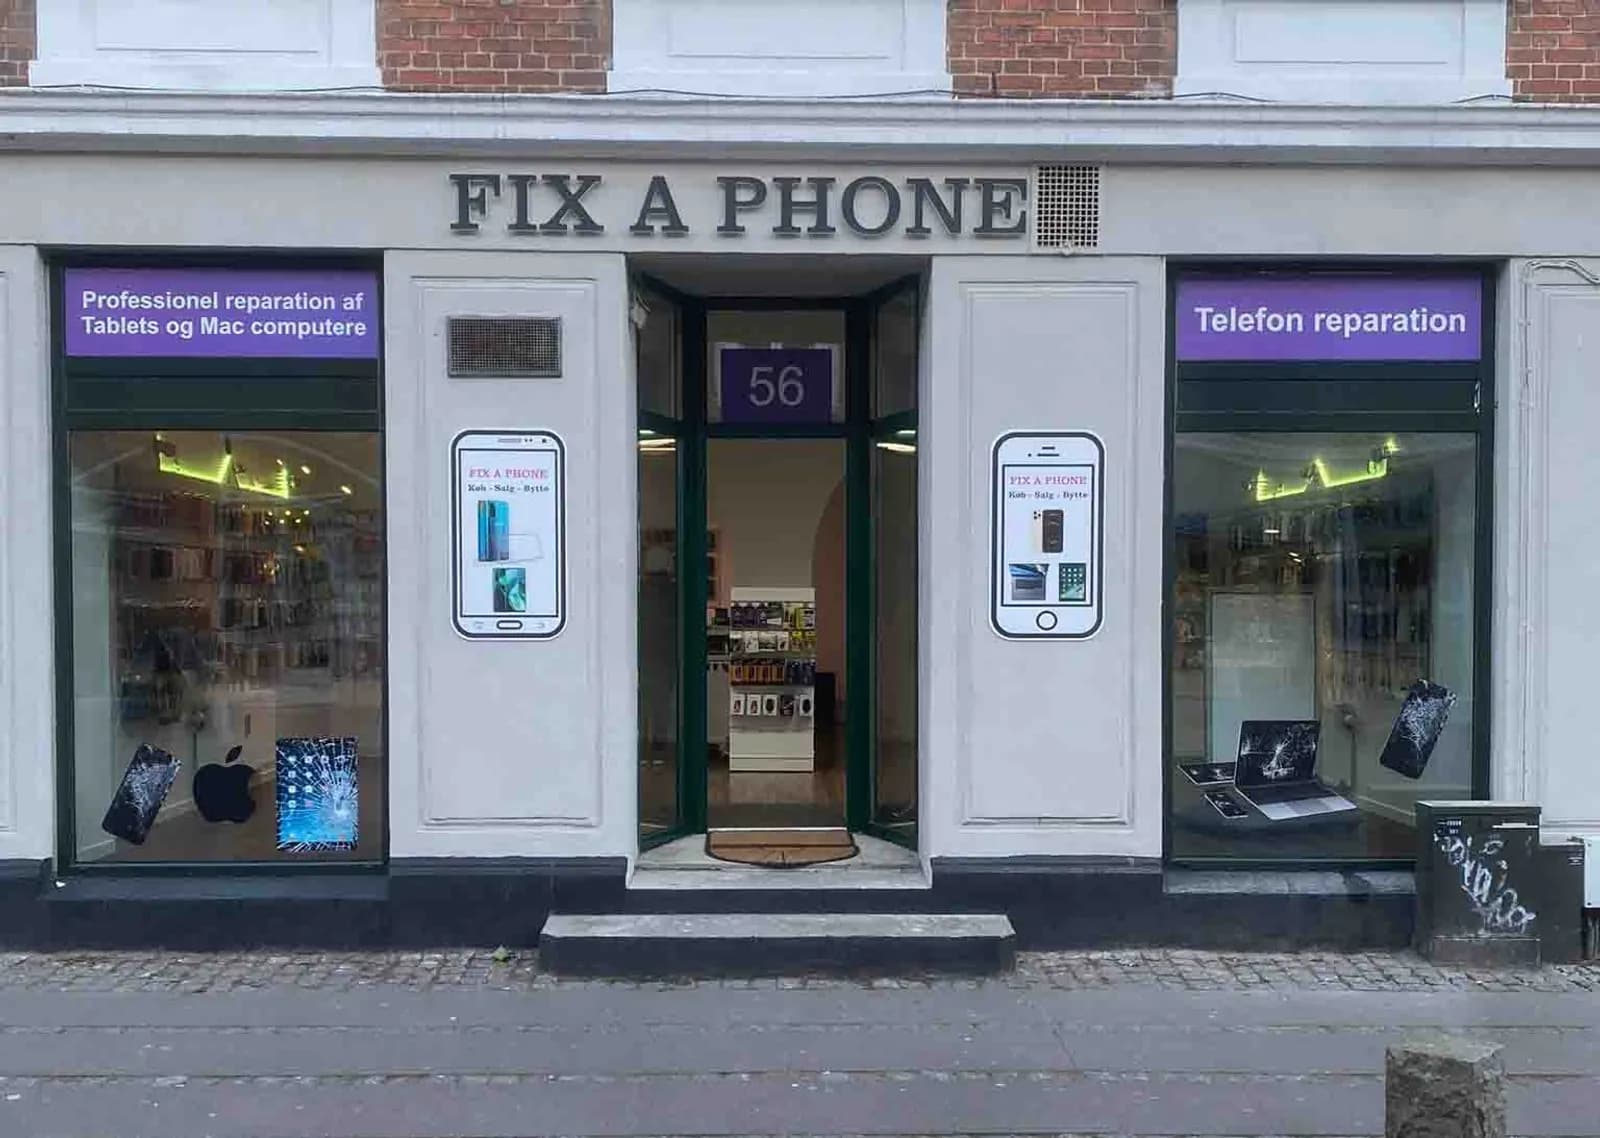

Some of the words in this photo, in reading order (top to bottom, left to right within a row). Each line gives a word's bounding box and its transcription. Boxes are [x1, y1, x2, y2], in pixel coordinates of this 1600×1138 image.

[450, 174, 604, 237] FIX
[630, 176, 689, 238] A
[716, 176, 1027, 240] PHONE
[82, 290, 218, 310] Professionel
[226, 292, 336, 314] reparation
[342, 292, 364, 310] af
[82, 316, 159, 335] Tablets
[166, 320, 193, 338] og
[201, 316, 245, 335] Mac
[251, 318, 367, 339] computere
[1195, 306, 1303, 332] Telefon
[1314, 307, 1466, 338] reparation
[749, 365, 805, 406] 56
[470, 469, 490, 478] FIX
[493, 469, 502, 478] A
[505, 469, 549, 479] PHONE
[1010, 476, 1031, 485] FIX
[1034, 476, 1042, 485] A
[1045, 476, 1088, 485] PHONE
